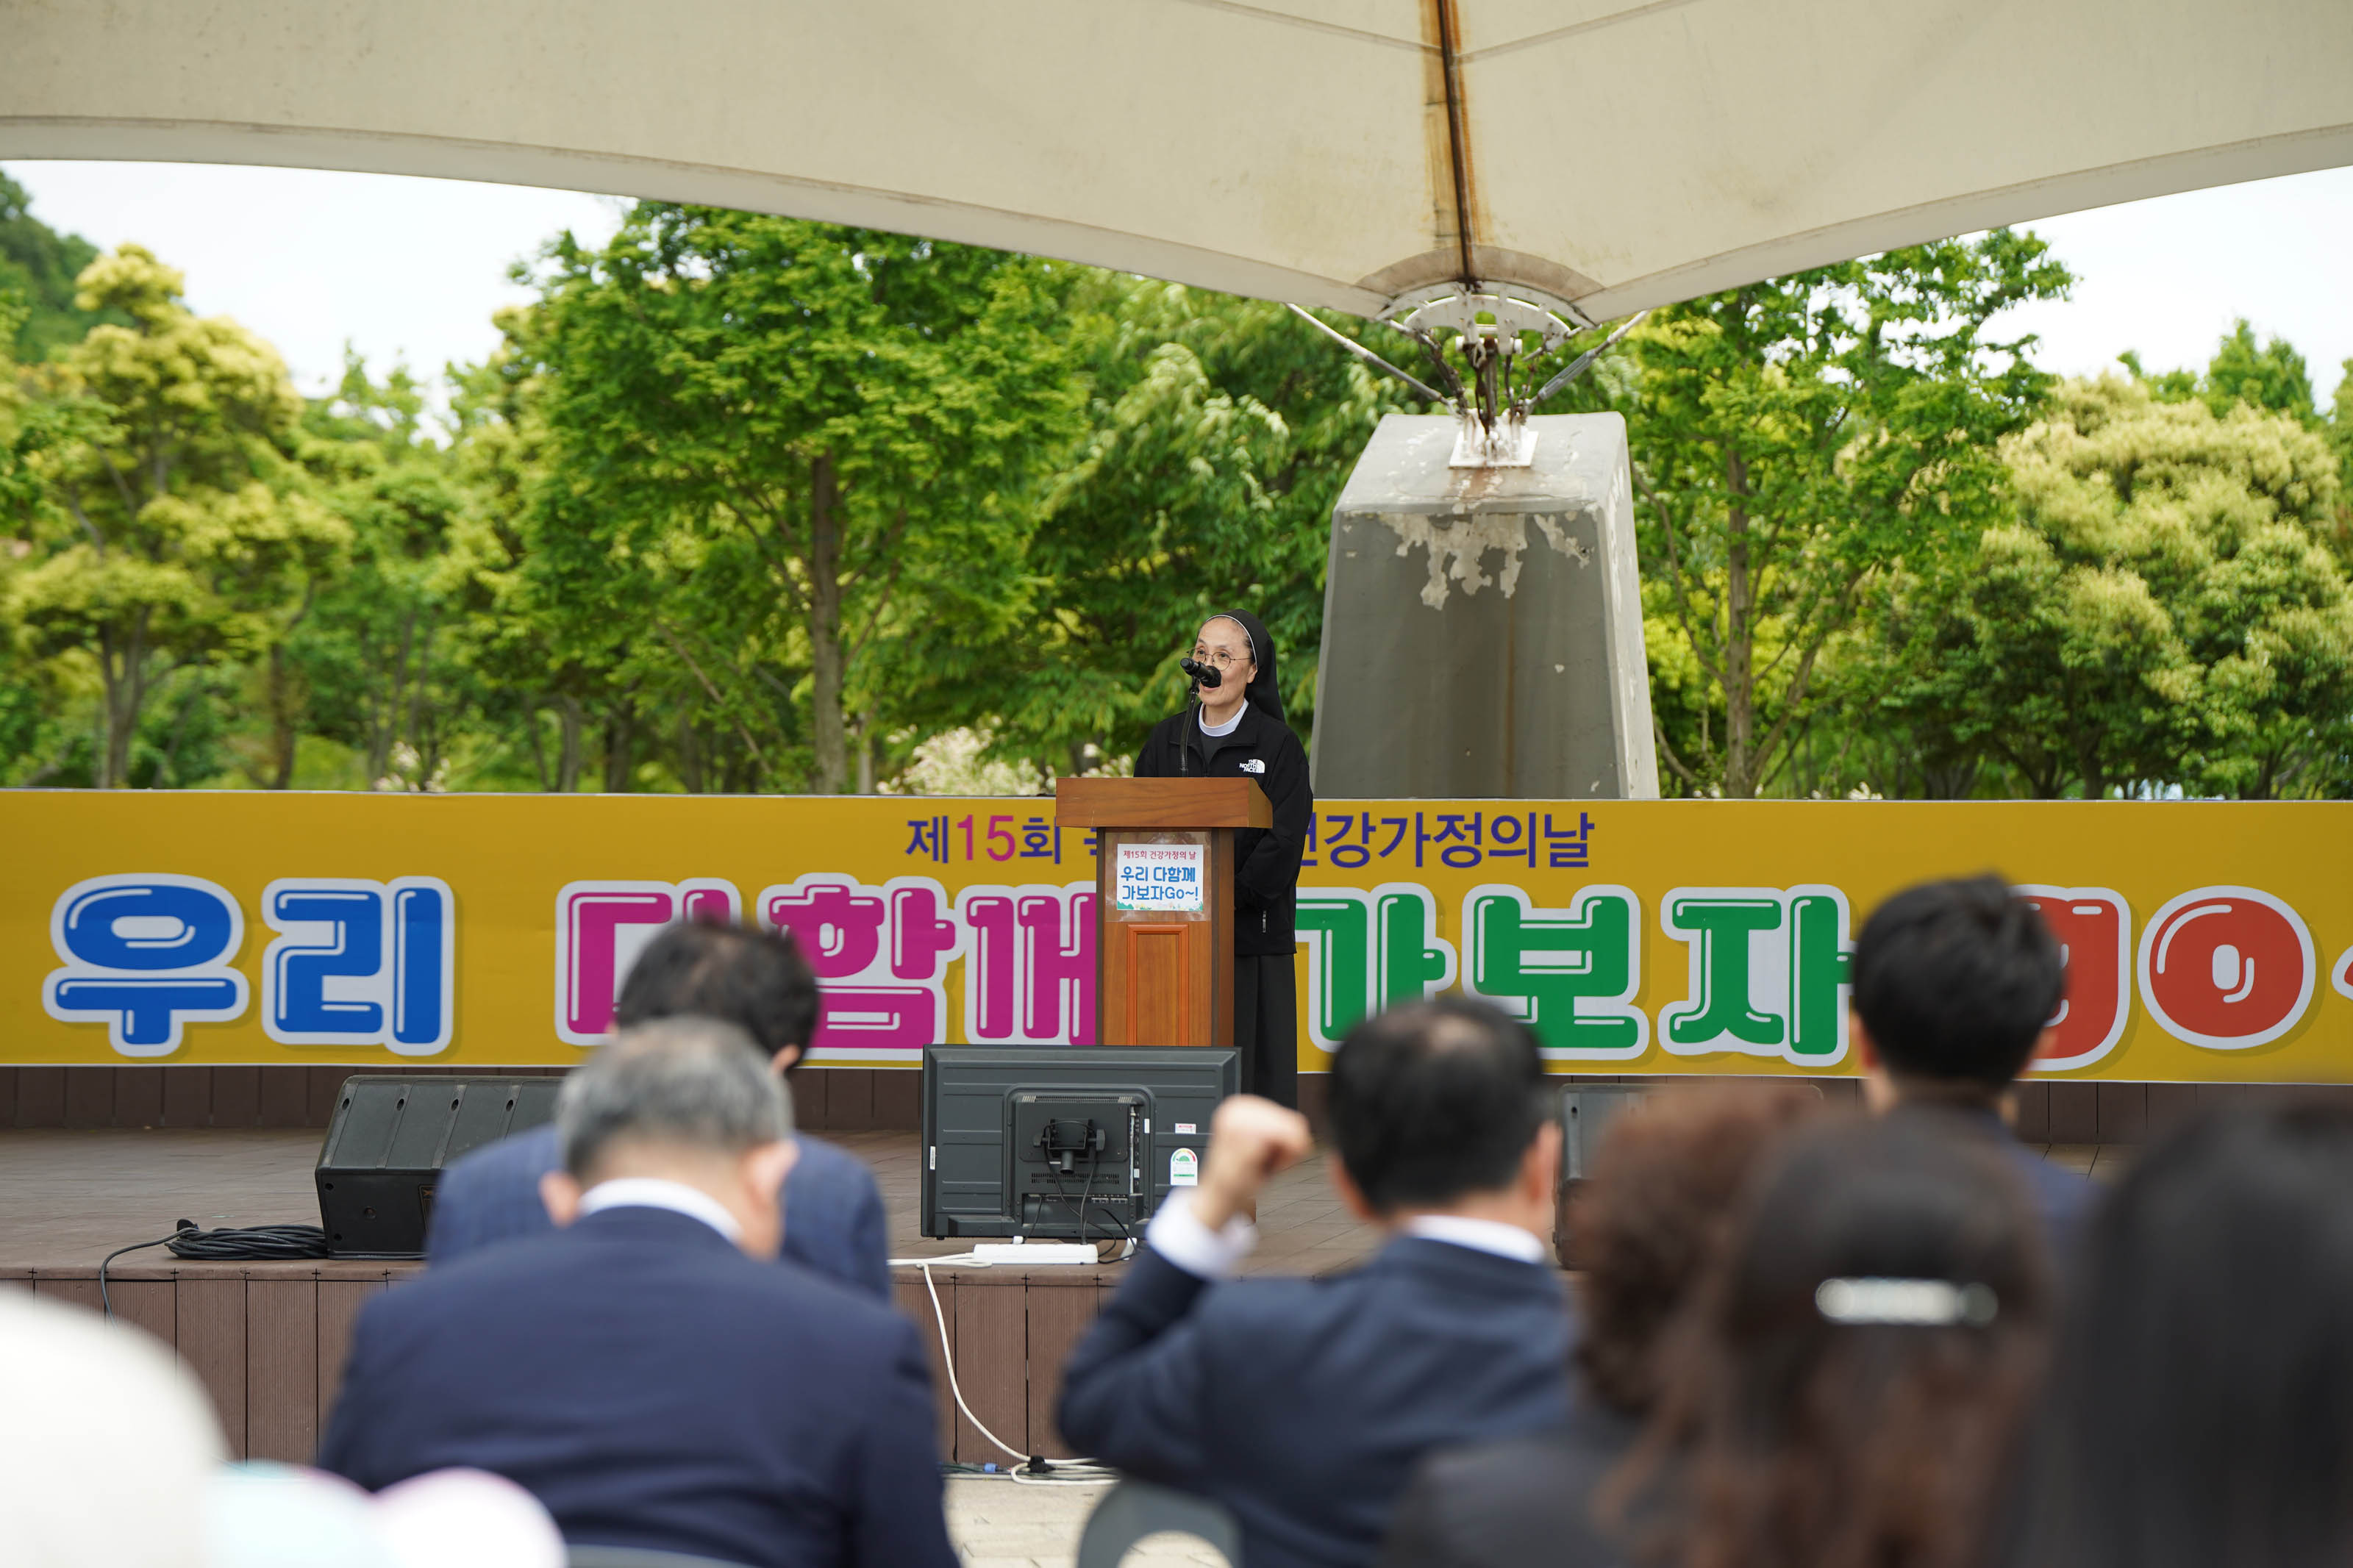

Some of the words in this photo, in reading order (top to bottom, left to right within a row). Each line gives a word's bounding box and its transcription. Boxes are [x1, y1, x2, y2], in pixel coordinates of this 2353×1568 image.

[906, 815, 1061, 864] 제15회
[1123, 850, 1147, 859] 제15회
[1150, 851, 1187, 860] 건강가정의
[1188, 851, 1196, 860] 날
[1121, 866, 1149, 881] 우리
[1153, 866, 1196, 883] 다함께
[1122, 885, 1199, 901] 가보자Go~!
[50, 880, 447, 1050] 우리
